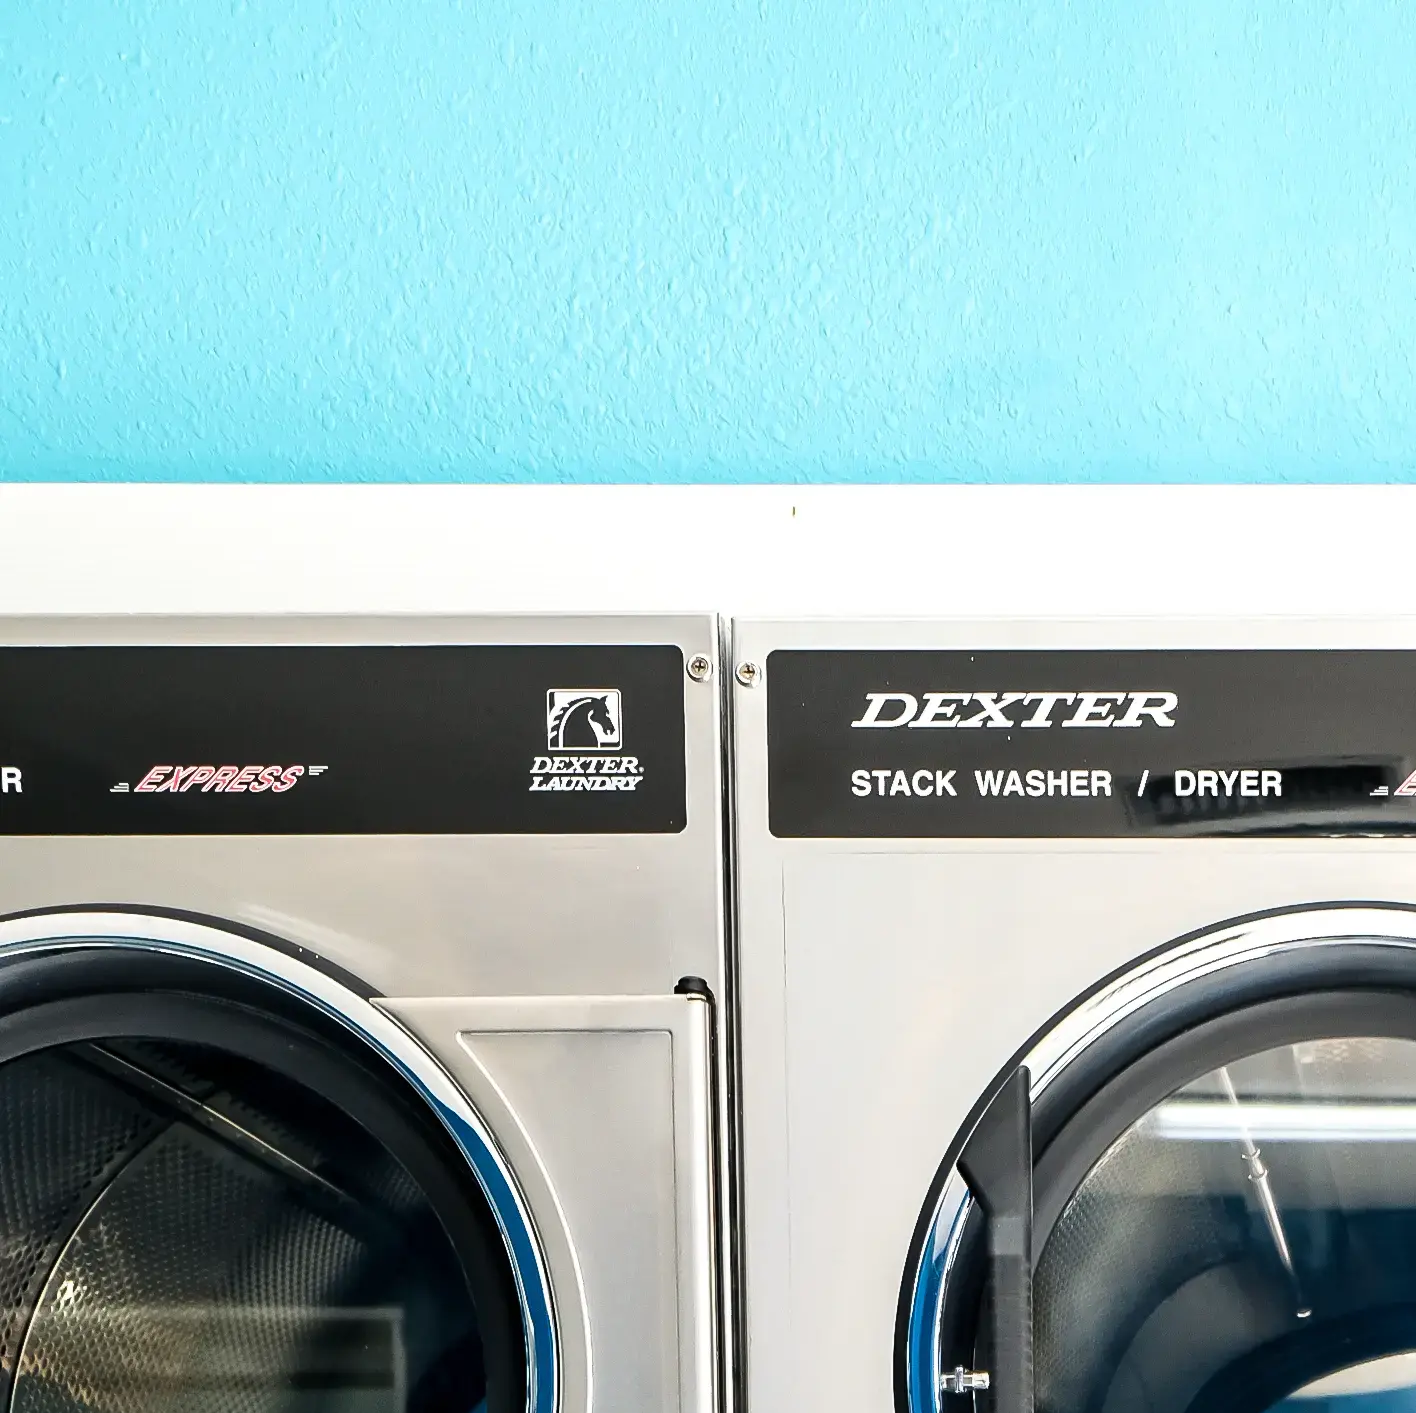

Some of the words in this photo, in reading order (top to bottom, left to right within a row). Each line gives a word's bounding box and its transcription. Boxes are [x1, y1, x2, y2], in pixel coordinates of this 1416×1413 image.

[851, 692, 1179, 728] DEXTER
[134, 765, 305, 793] EXPRESS
[530, 757, 640, 774] DEXTER
[530, 776, 643, 791] LAUNDRY
[851, 770, 957, 797] STACK
[975, 770, 1111, 797] WASHER
[1175, 770, 1283, 797] DRYER
